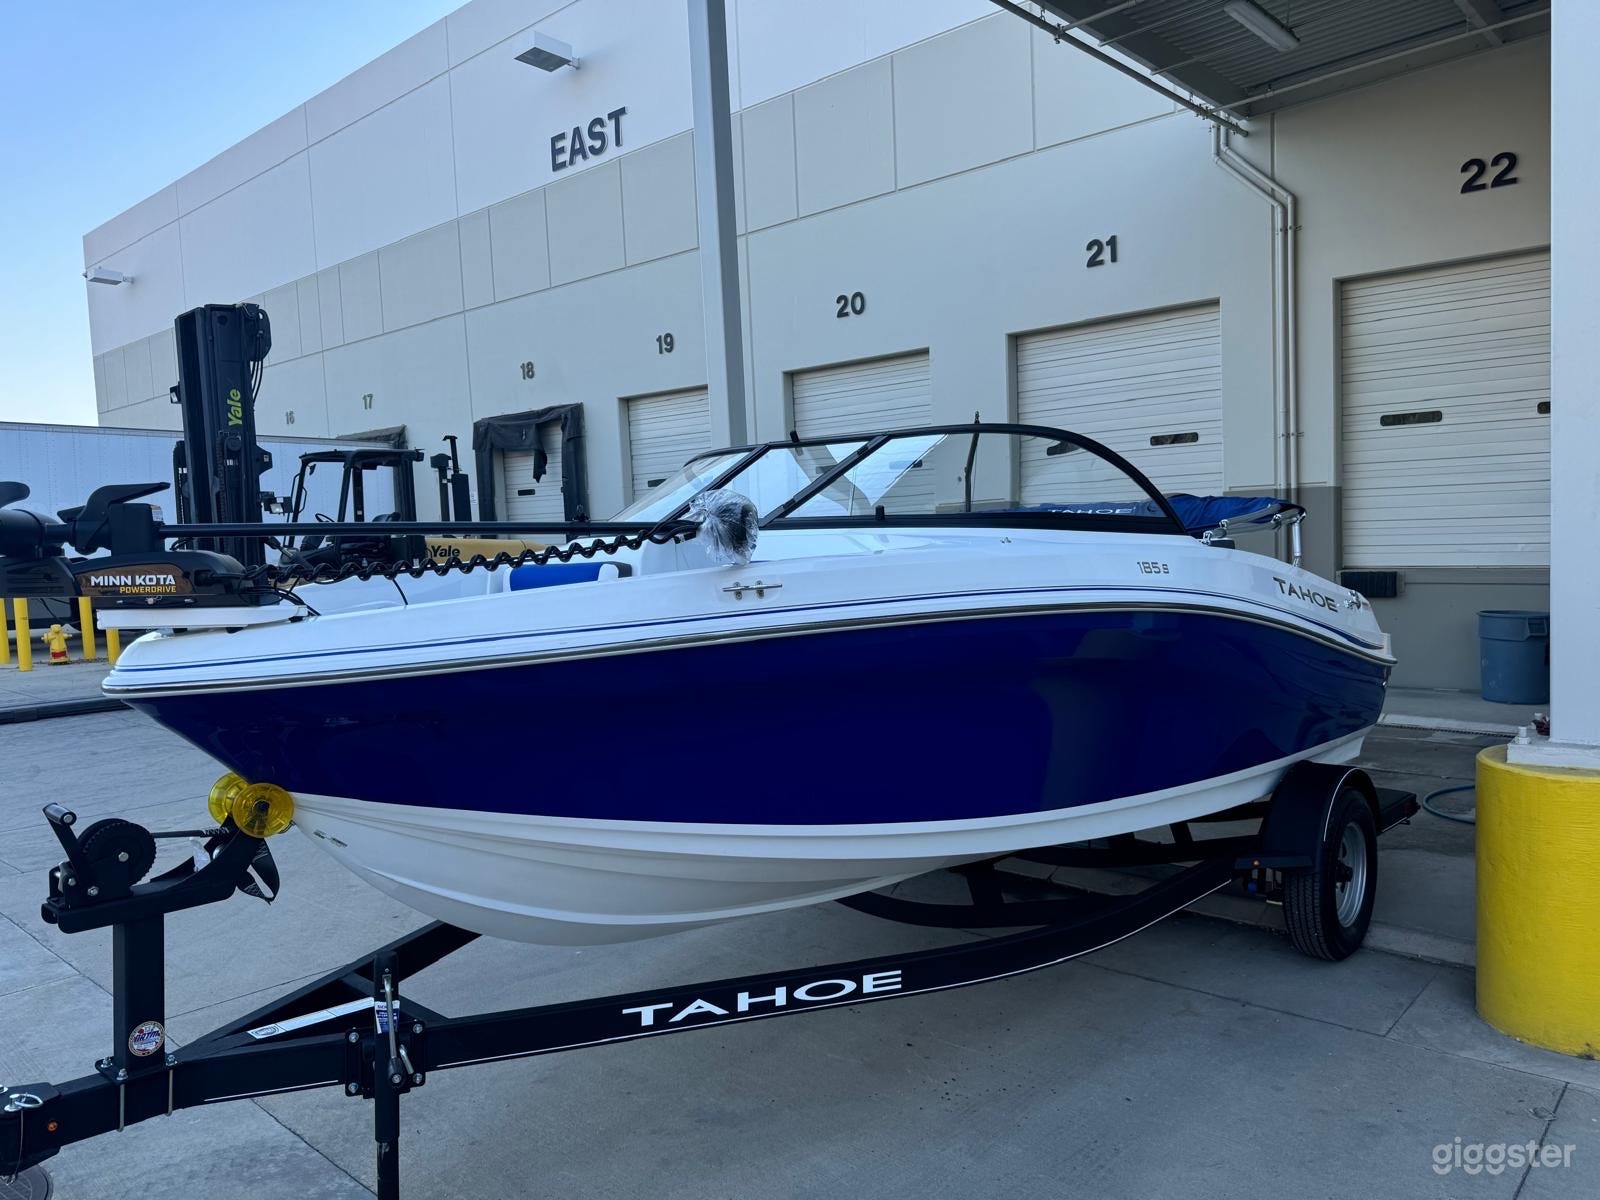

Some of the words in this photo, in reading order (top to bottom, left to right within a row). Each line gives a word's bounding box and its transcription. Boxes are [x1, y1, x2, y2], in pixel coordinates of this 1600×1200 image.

[550, 106, 627, 172] EAST
[1460, 152, 1519, 194] 22
[1086, 235, 1119, 268] 21
[835, 291, 866, 318] 20
[655, 333, 674, 354] 19
[520, 361, 535, 380] 18
[227, 388, 242, 426] Yale
[362, 394, 373, 410] 17
[431, 545, 460, 557] Yale
[91, 575, 132, 586] MINN
[135, 574, 176, 586] KOTA
[120, 586, 177, 594] POWERDRIVE
[1273, 576, 1339, 613] TAHOE
[622, 970, 902, 1026] TAHOE
